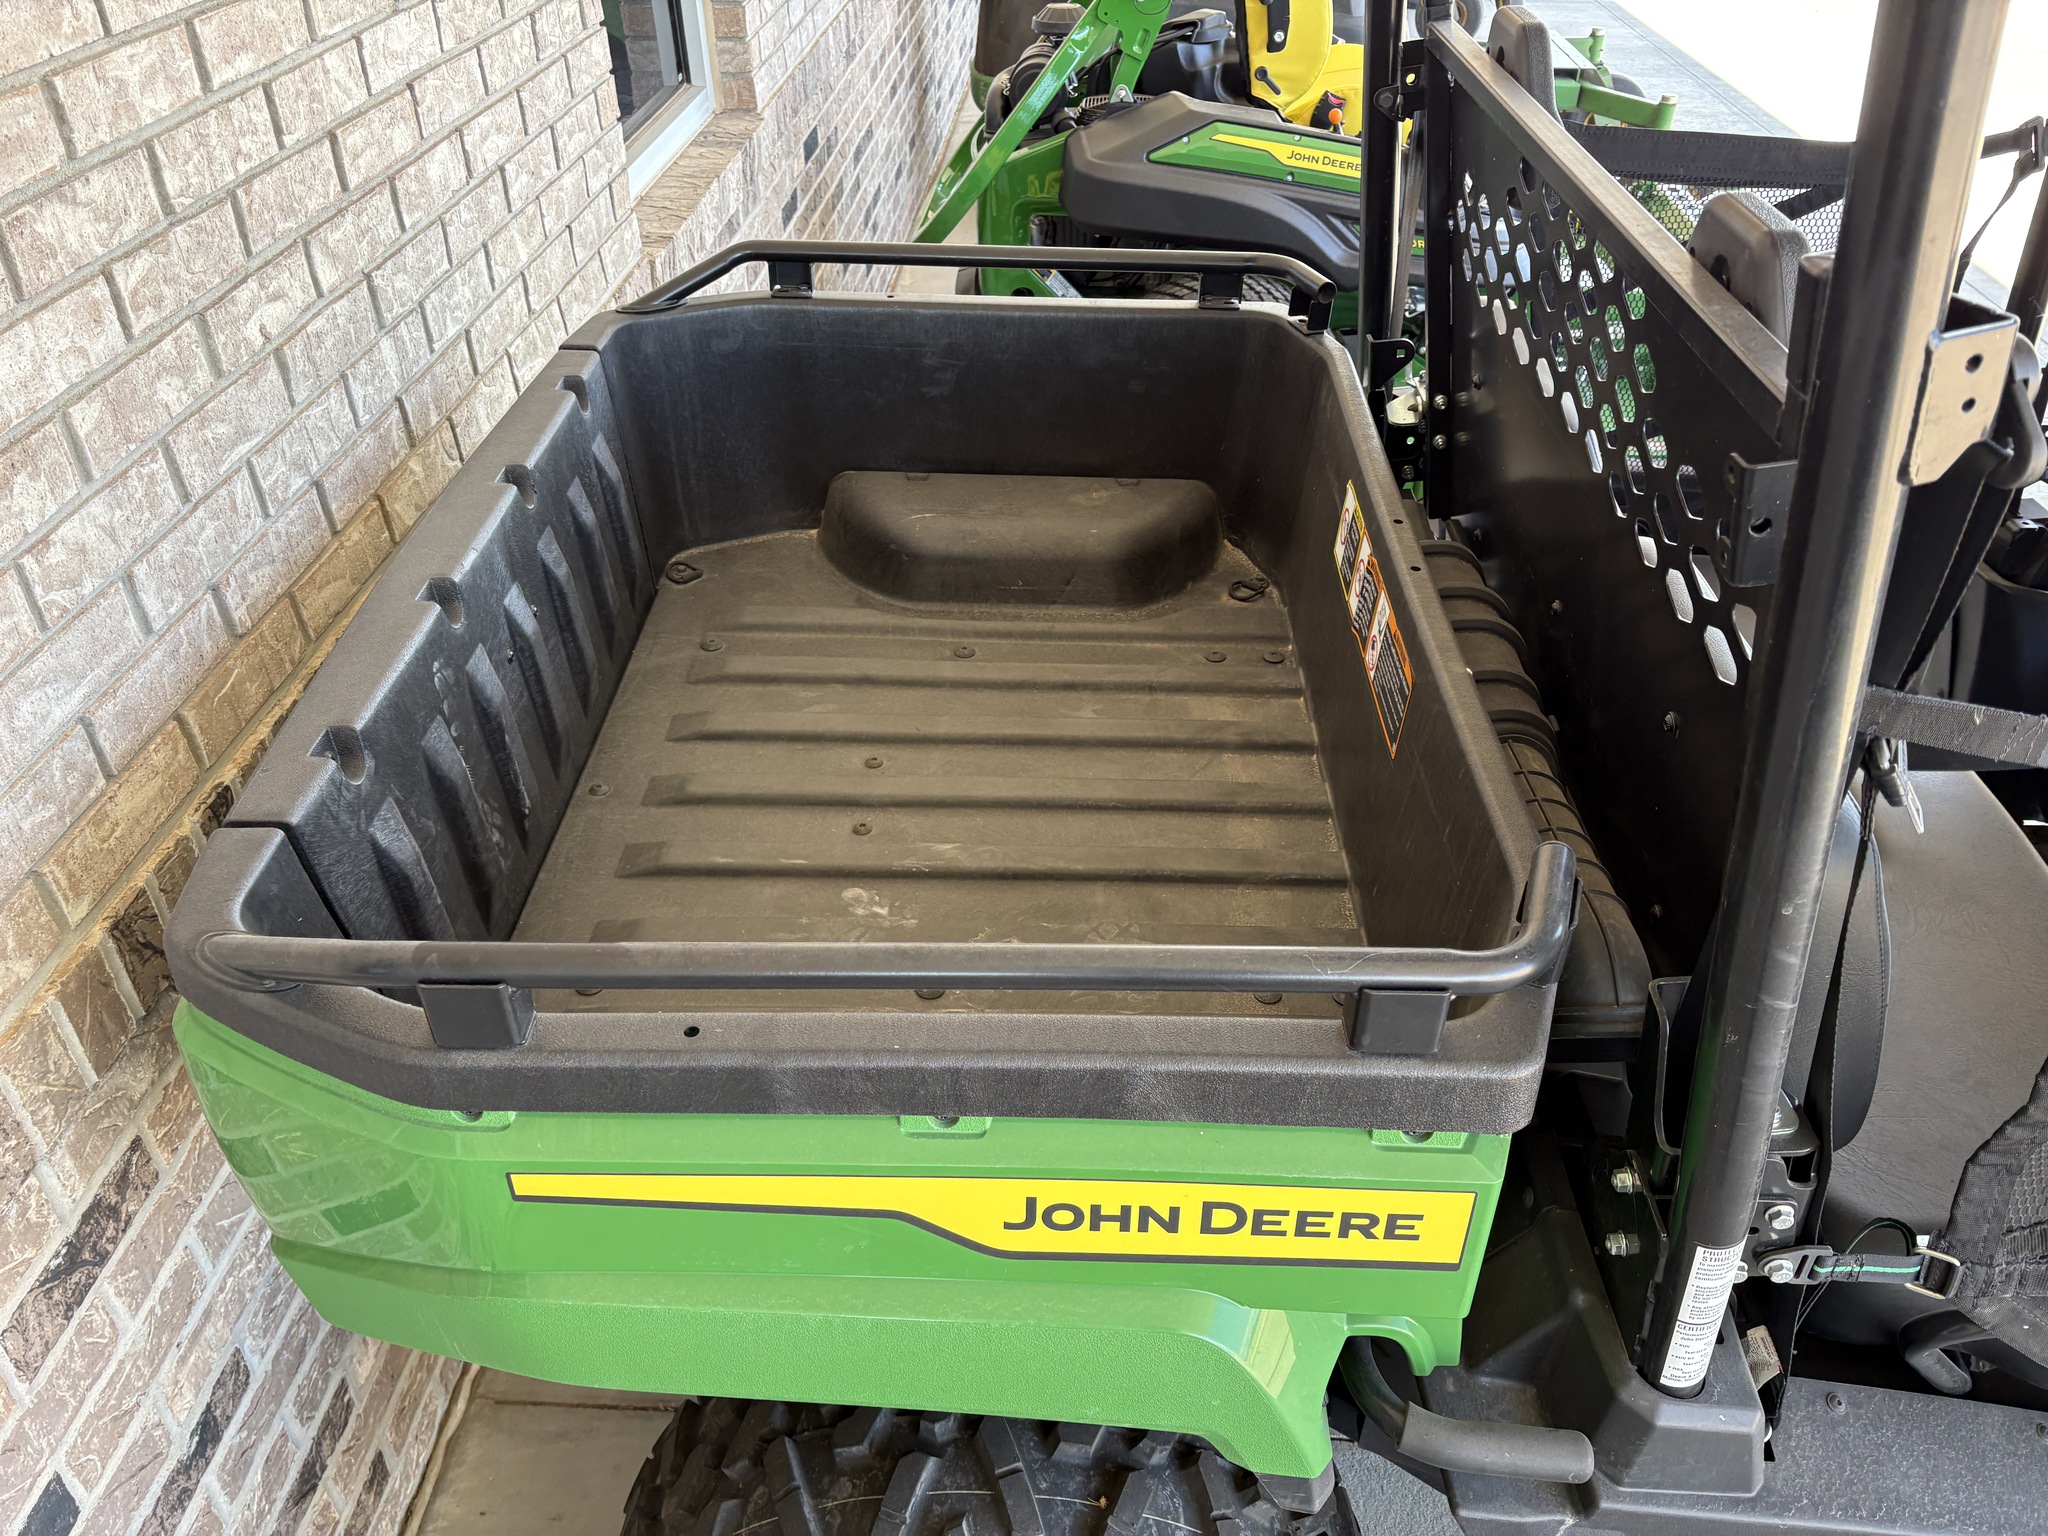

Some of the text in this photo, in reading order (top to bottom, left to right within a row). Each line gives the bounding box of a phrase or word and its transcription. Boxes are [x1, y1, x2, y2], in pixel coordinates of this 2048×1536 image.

[1286, 150, 1362, 172] JOHN DEERE
[1003, 1196, 1425, 1241] JOHN DEERE
